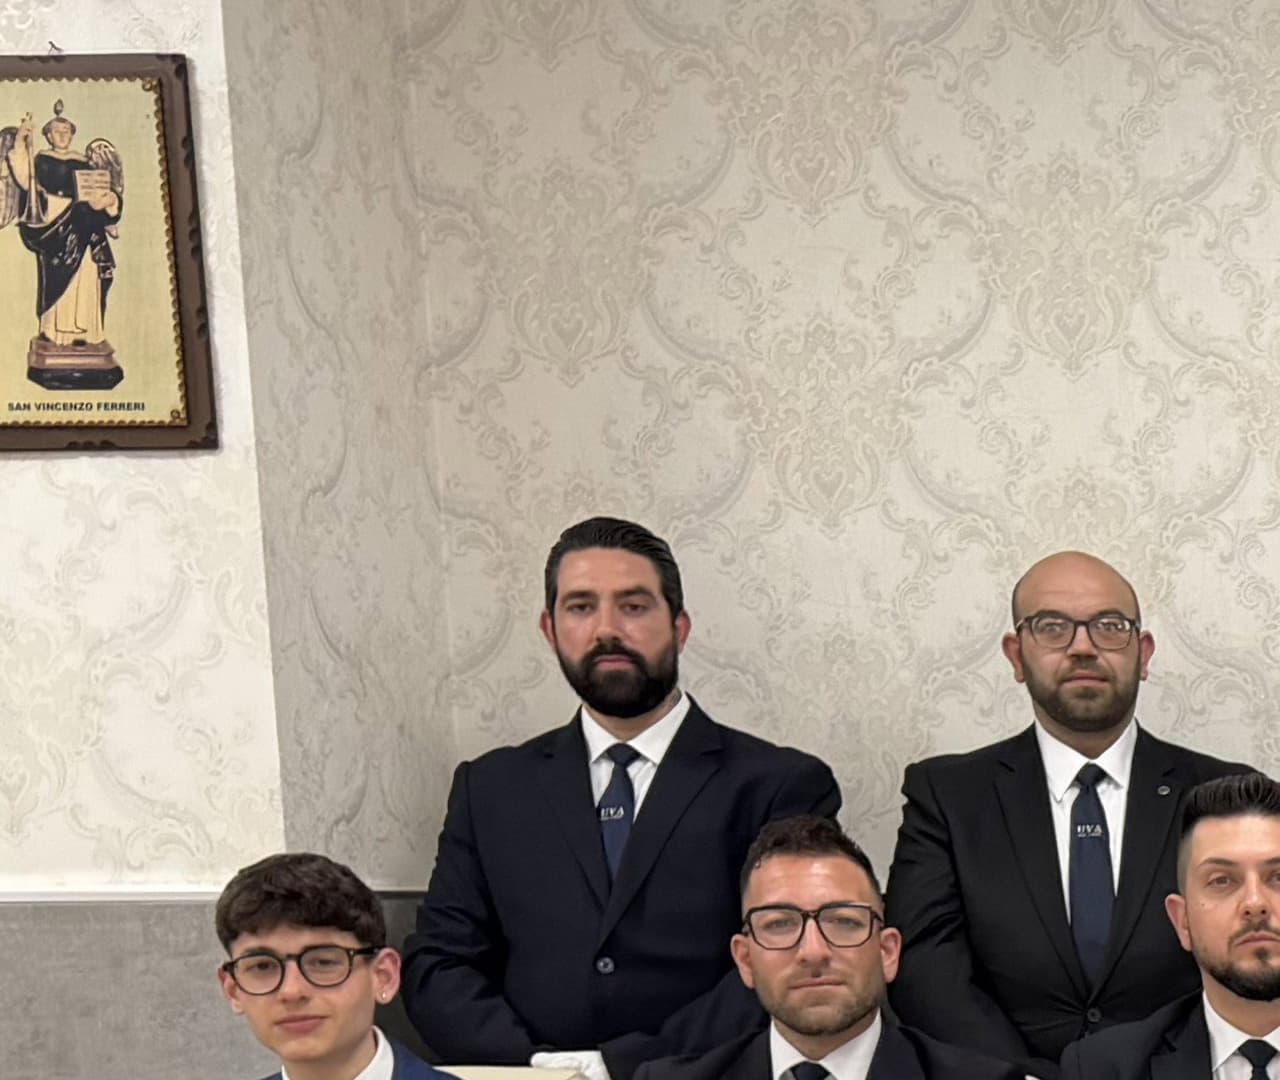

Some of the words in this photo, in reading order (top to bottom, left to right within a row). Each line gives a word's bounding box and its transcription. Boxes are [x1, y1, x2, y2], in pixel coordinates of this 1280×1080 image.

[8, 402, 31, 412] SAN
[34, 402, 93, 412] VINCENZO
[96, 402, 145, 412] FERRERI
[601, 806, 624, 817] UVA
[1077, 824, 1102, 833] UVA
